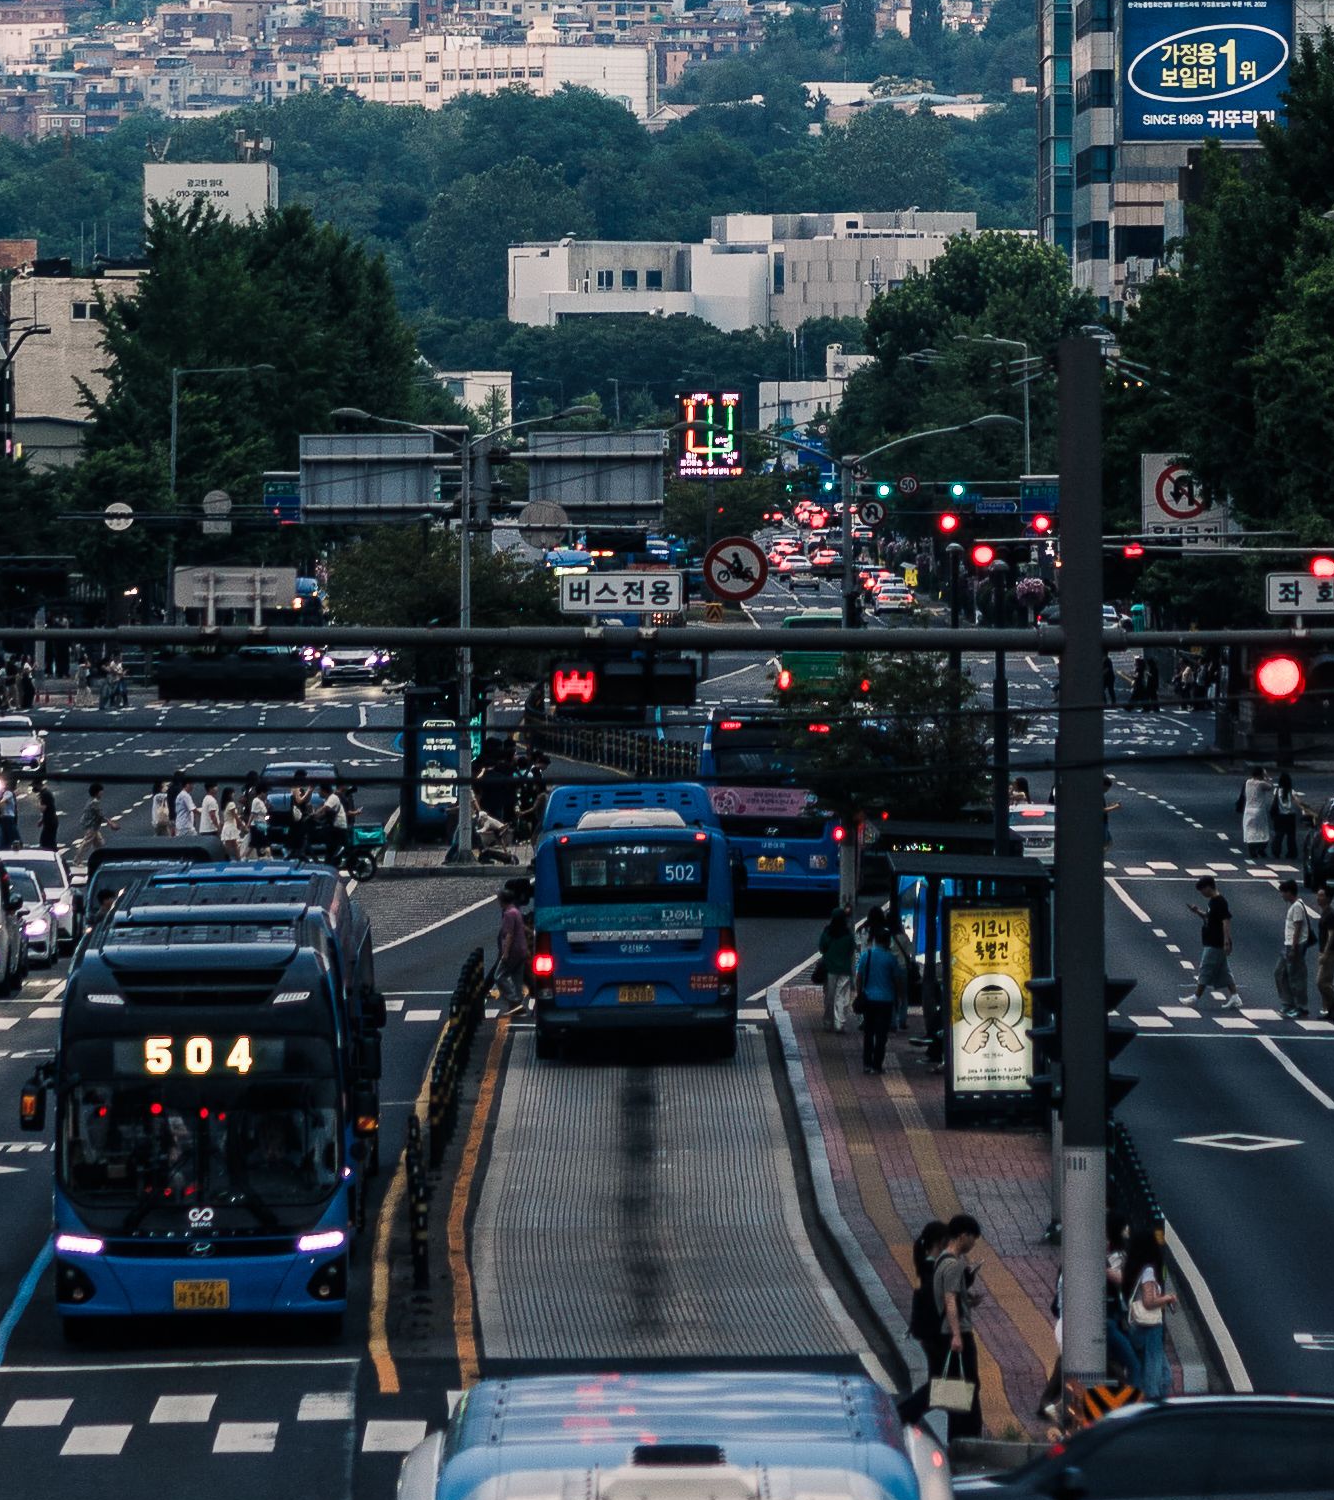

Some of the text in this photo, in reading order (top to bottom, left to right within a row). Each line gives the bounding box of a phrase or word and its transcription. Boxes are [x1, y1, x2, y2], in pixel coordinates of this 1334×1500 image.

[1160, 43, 1217, 65] 가정용
[1160, 67, 1216, 89] 보일러
[1142, 114, 1177, 126] SINCE
[1178, 113, 1204, 125] 1969
[901, 479, 916, 490] 50
[568, 578, 676, 607] 버스전용
[665, 864, 695, 881] 502
[971, 919, 1011, 939] 키크니
[974, 941, 1009, 961] 특별전
[145, 1035, 254, 1075] 504
